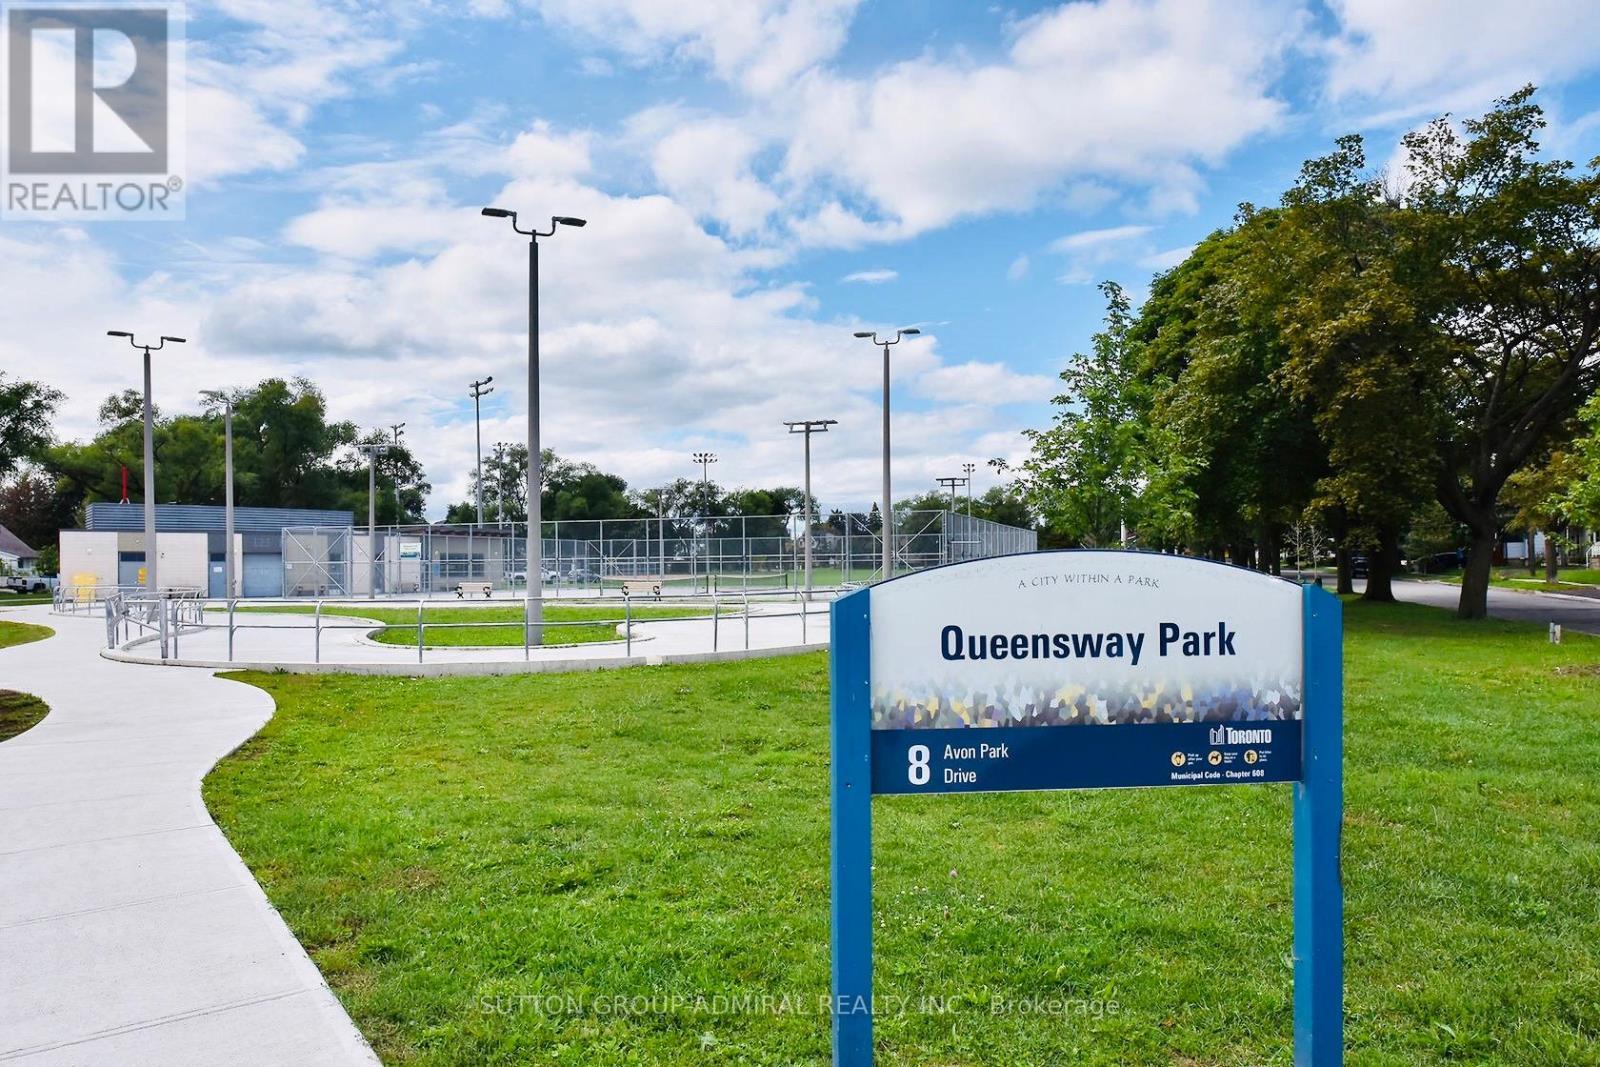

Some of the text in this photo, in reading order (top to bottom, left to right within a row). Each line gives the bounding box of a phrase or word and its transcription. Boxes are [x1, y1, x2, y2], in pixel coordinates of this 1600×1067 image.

[1018, 574, 1160, 589] A CITY WITHIN A PARK
[941, 621, 1236, 666] Queensway Park
[1225, 727, 1272, 745] TORONTO
[943, 743, 1009, 760] Avon Park
[907, 745, 930, 785] 8
[943, 768, 977, 784] Drive
[1171, 771, 1203, 781] Municipal
[1204, 771, 1221, 779] Code
[1225, 770, 1251, 779] Chapter
[1251, 769, 1265, 778] 608
